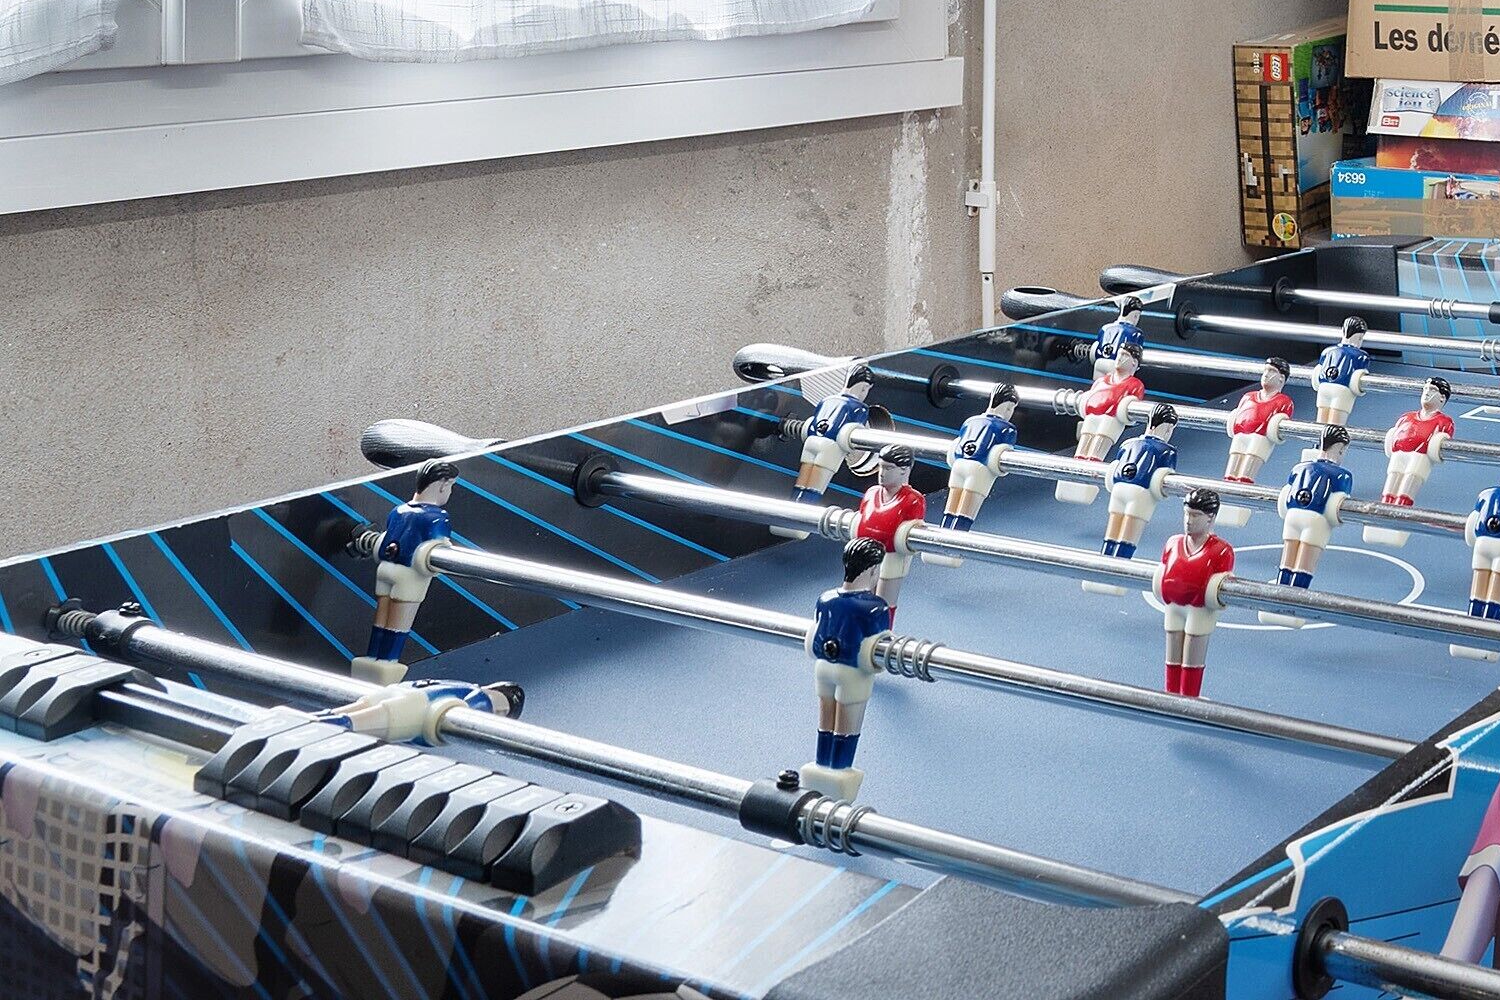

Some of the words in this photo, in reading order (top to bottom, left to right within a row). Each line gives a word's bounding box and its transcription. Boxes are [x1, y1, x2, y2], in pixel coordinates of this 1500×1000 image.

[1373, 21, 1418, 52] Les
[1270, 54, 1283, 81] LEGO
[1386, 86, 1434, 99] science
[1337, 171, 1366, 185] 6634
